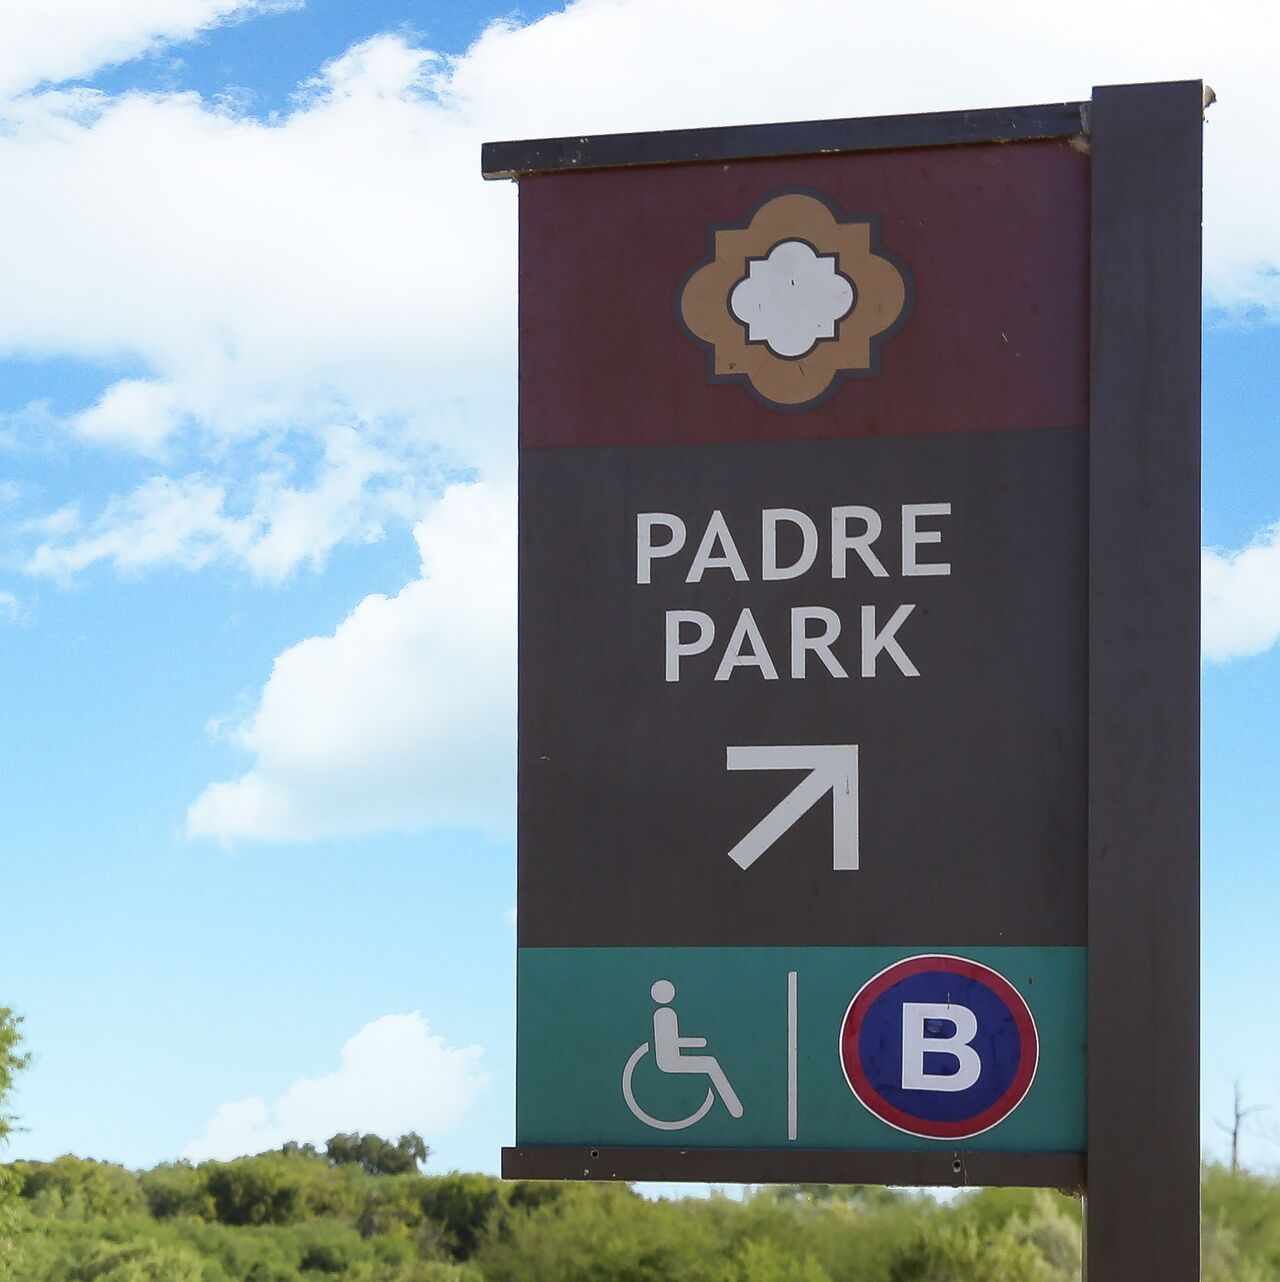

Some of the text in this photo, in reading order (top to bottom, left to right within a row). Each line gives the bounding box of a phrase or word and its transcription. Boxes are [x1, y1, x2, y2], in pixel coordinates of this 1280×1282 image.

[636, 502, 952, 585] PADRE
[665, 603, 921, 682] PARK
[901, 1002, 981, 1092] B
